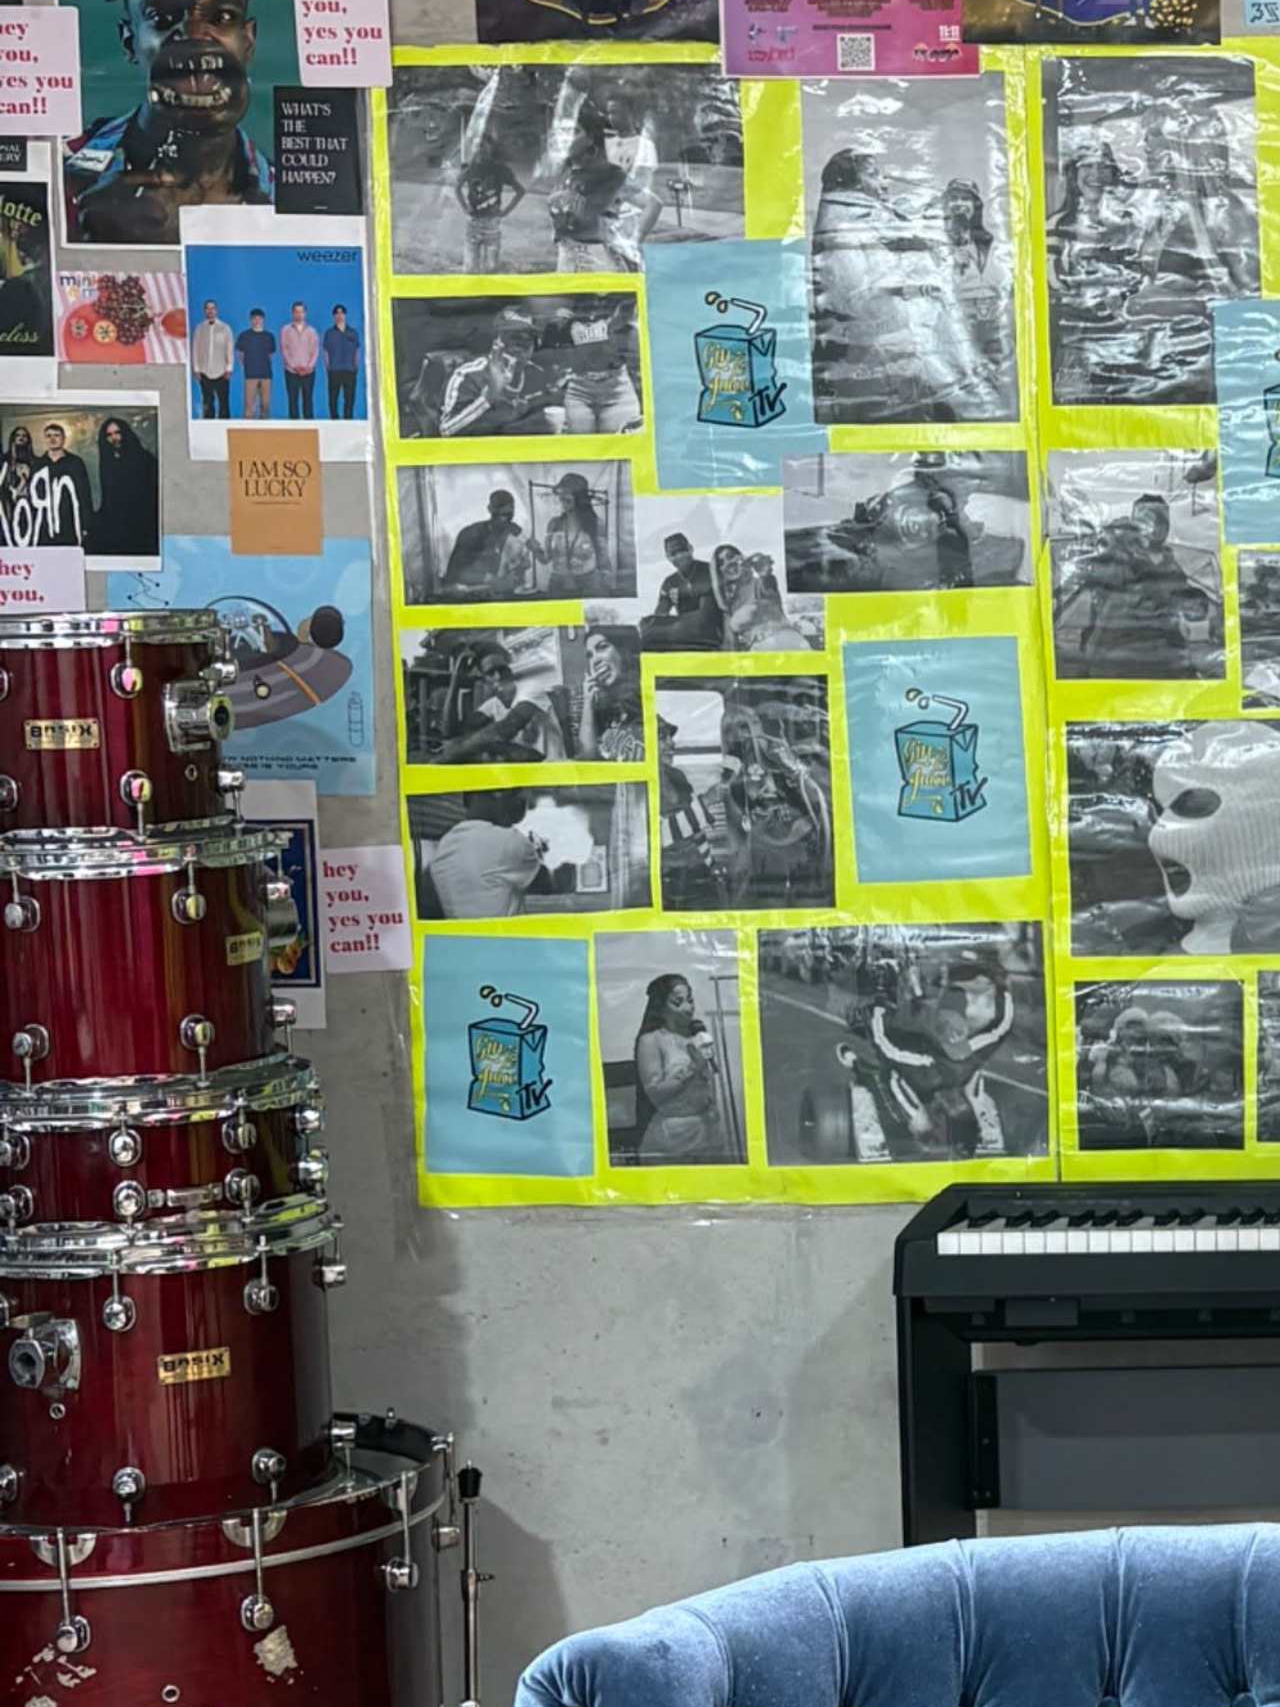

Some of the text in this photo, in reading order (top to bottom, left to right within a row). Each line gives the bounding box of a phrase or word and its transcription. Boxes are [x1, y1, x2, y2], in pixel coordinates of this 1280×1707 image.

[303, 23, 384, 44] yes you
[305, 45, 358, 67] can!!
[35, 75, 74, 94] you
[282, 102, 332, 118] WHAT'S
[282, 119, 306, 133] THE
[282, 135, 348, 151] BEST THAT
[282, 153, 329, 168] COULD
[282, 170, 336, 185] HAPPEN?
[298, 249, 359, 264] weezer
[748, 382, 788, 417] TV
[237, 459, 313, 480] I AM SO
[243, 479, 306, 499] LUCKY
[949, 777, 988, 811] TV
[323, 861, 358, 881] hey
[326, 891, 369, 907] you,
[328, 912, 403, 932] yes you
[330, 934, 380, 952] can!!
[516, 1078, 553, 1110] TV
